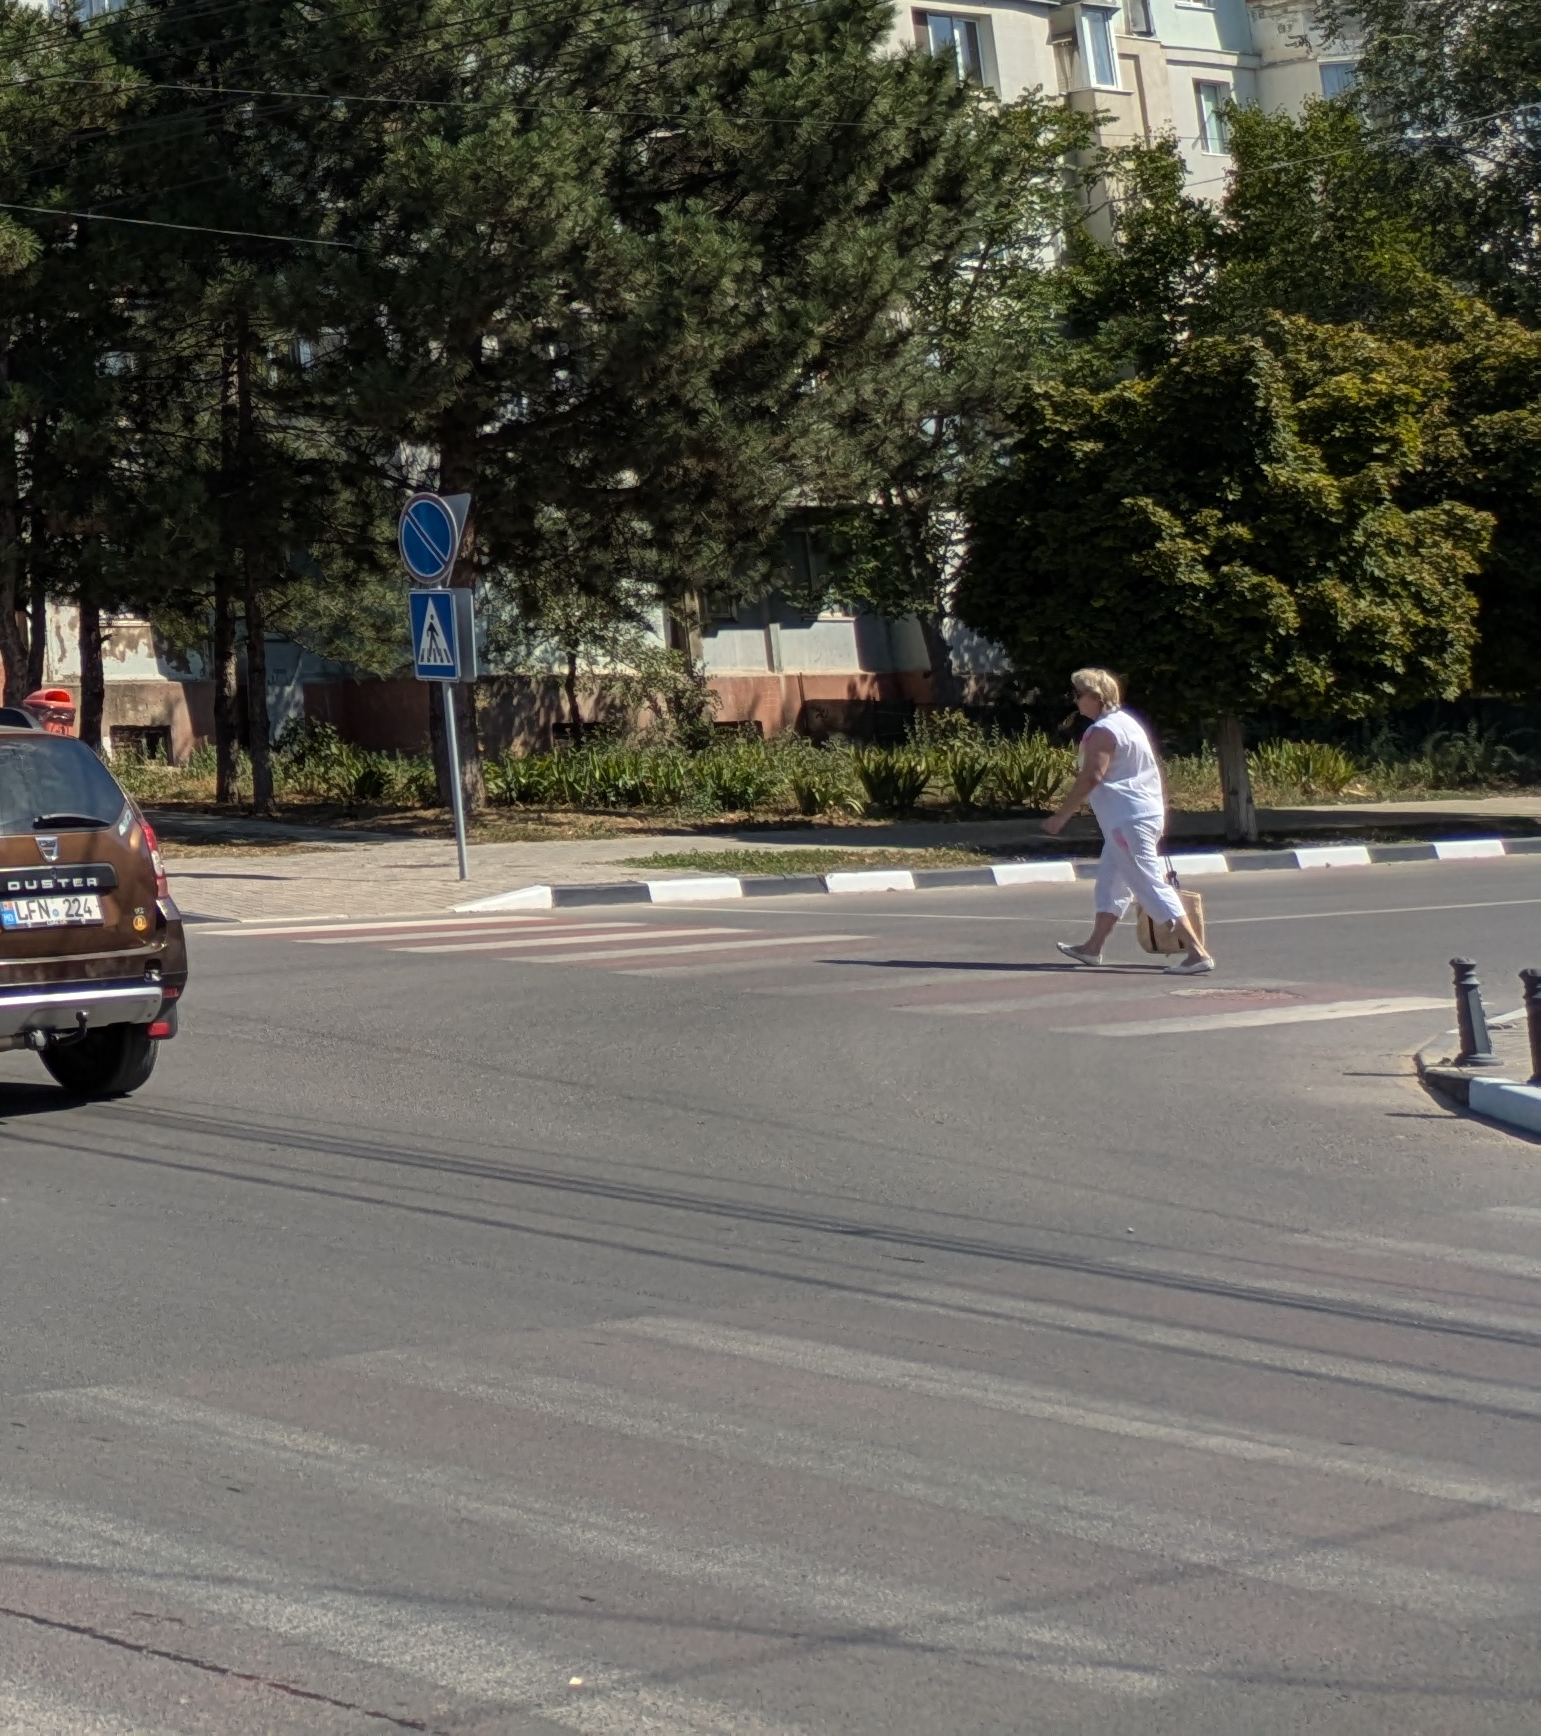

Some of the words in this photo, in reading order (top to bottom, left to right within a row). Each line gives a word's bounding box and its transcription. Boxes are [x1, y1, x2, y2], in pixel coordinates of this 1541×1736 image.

[7, 877, 98, 891] DUSTER
[14, 898, 51, 921] LFN
[62, 897, 93, 918] 224
